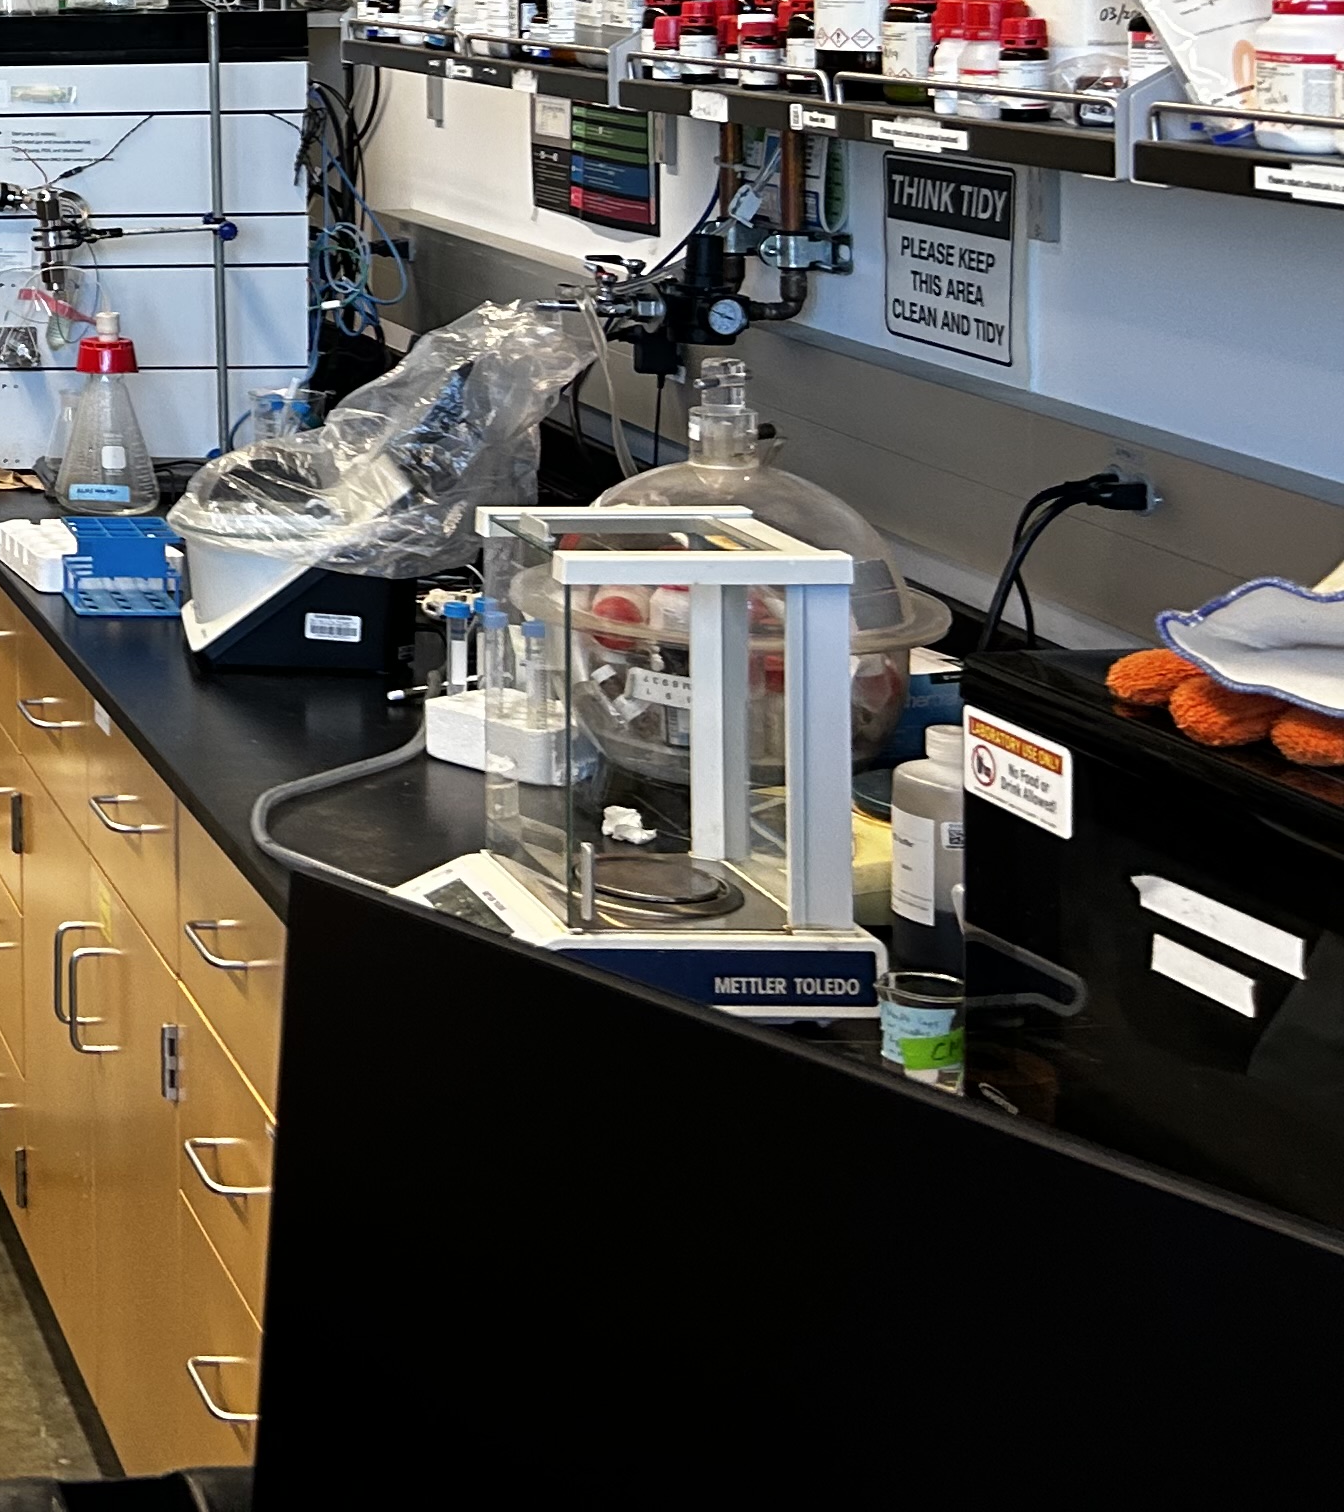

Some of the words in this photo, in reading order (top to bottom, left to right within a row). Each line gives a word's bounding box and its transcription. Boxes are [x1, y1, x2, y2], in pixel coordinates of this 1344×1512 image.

[892, 174, 955, 214] THINK
[960, 185, 1008, 222] TIDY
[901, 236, 955, 266] PLEASE
[958, 247, 995, 274] KEEP
[911, 270, 942, 297] THIS
[945, 279, 984, 307] AREA
[892, 298, 937, 329] CLEAN
[941, 310, 970, 336] AND
[973, 318, 1005, 346] TIDY
[971, 719, 1021, 755] LABORATORY
[1022, 744, 1039, 763] USE
[1039, 749, 1060, 772] ONLY
[1001, 775, 1021, 798] Drink
[1023, 787, 1057, 813] Allowed!
[1008, 763, 1019, 779] No
[1020, 769, 1039, 789] Food
[1040, 782, 1050, 793] or
[714, 977, 787, 994] METTLER
[793, 978, 860, 995] TOLEDO
